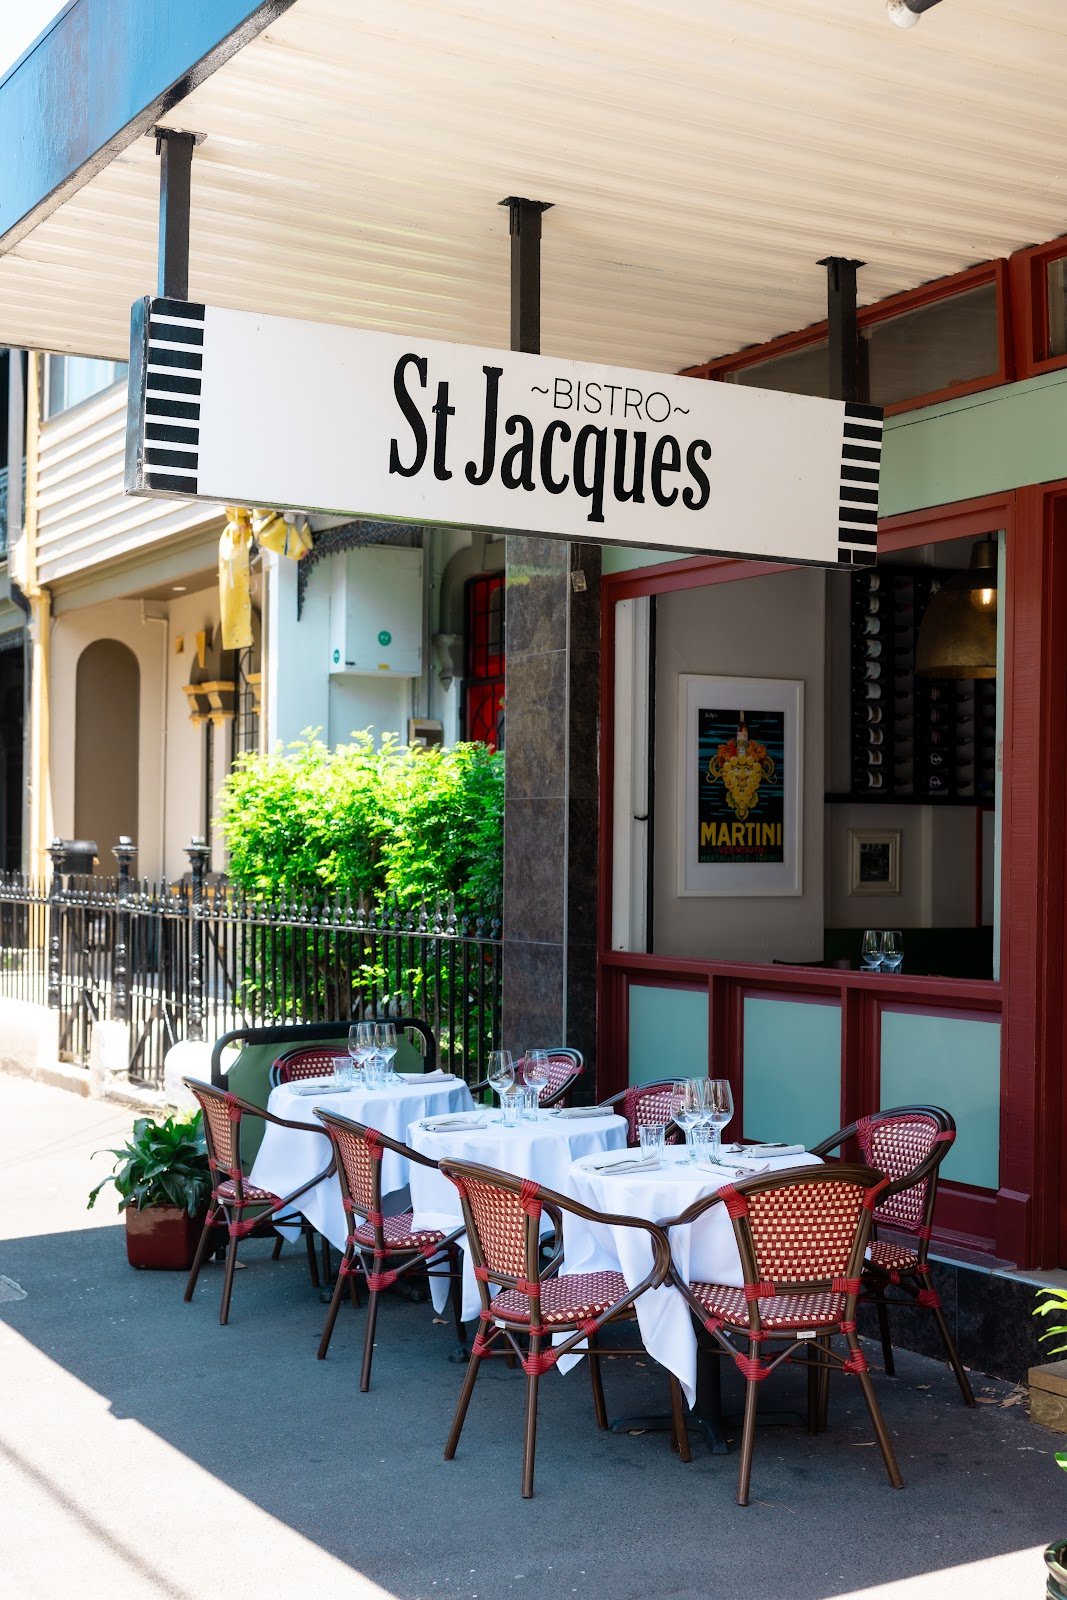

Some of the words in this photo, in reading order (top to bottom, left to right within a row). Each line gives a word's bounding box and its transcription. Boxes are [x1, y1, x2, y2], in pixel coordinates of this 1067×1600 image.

[389, 353, 456, 482] St
[465, 366, 712, 523] Jacques
[701, 822, 782, 847] MARTINI
